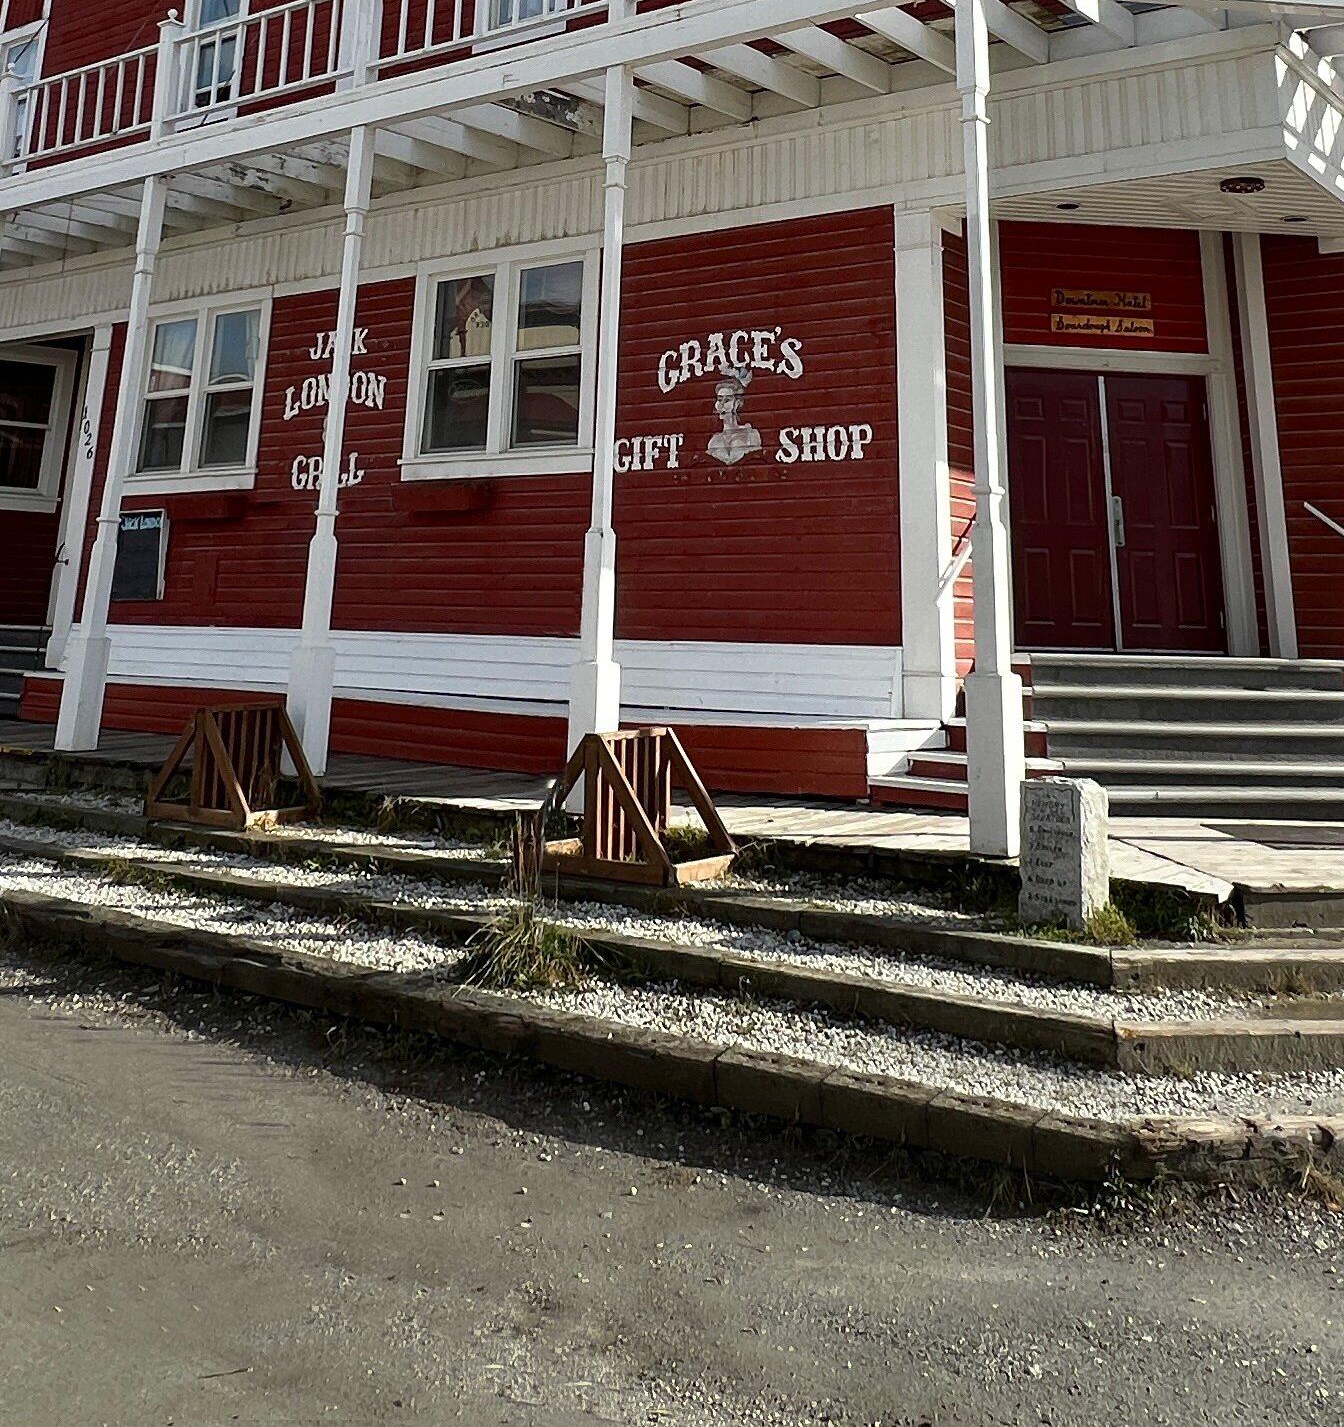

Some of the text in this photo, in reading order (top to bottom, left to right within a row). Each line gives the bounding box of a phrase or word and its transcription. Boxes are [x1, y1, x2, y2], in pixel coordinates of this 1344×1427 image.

[309, 328, 368, 360] JAK
[658, 327, 803, 393] GRACE'S
[283, 371, 387, 420] LONON
[81, 405, 94, 459] 1026
[613, 423, 872, 472] GIFT SHOP
